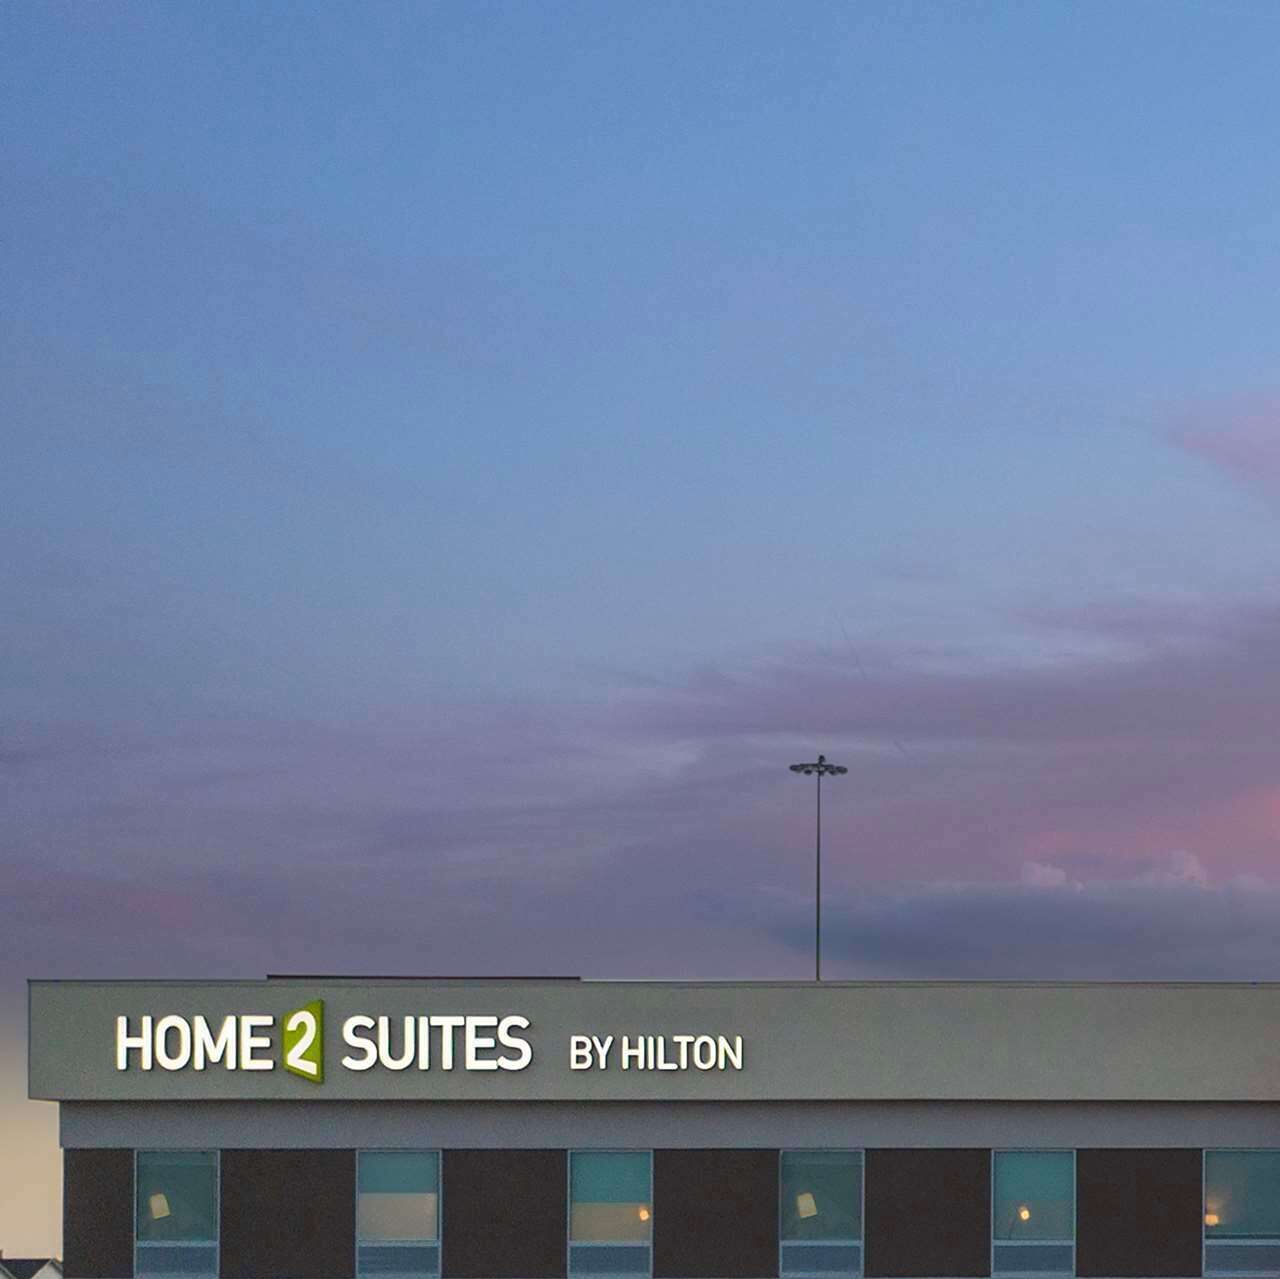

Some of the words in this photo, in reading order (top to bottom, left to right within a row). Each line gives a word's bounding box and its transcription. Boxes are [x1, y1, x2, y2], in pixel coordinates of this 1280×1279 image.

[116, 1015, 275, 1071] HOME
[286, 1010, 318, 1075] 2
[340, 1015, 533, 1071] SUITES
[569, 1035, 614, 1070] BY
[621, 1035, 743, 1070] HILTON
